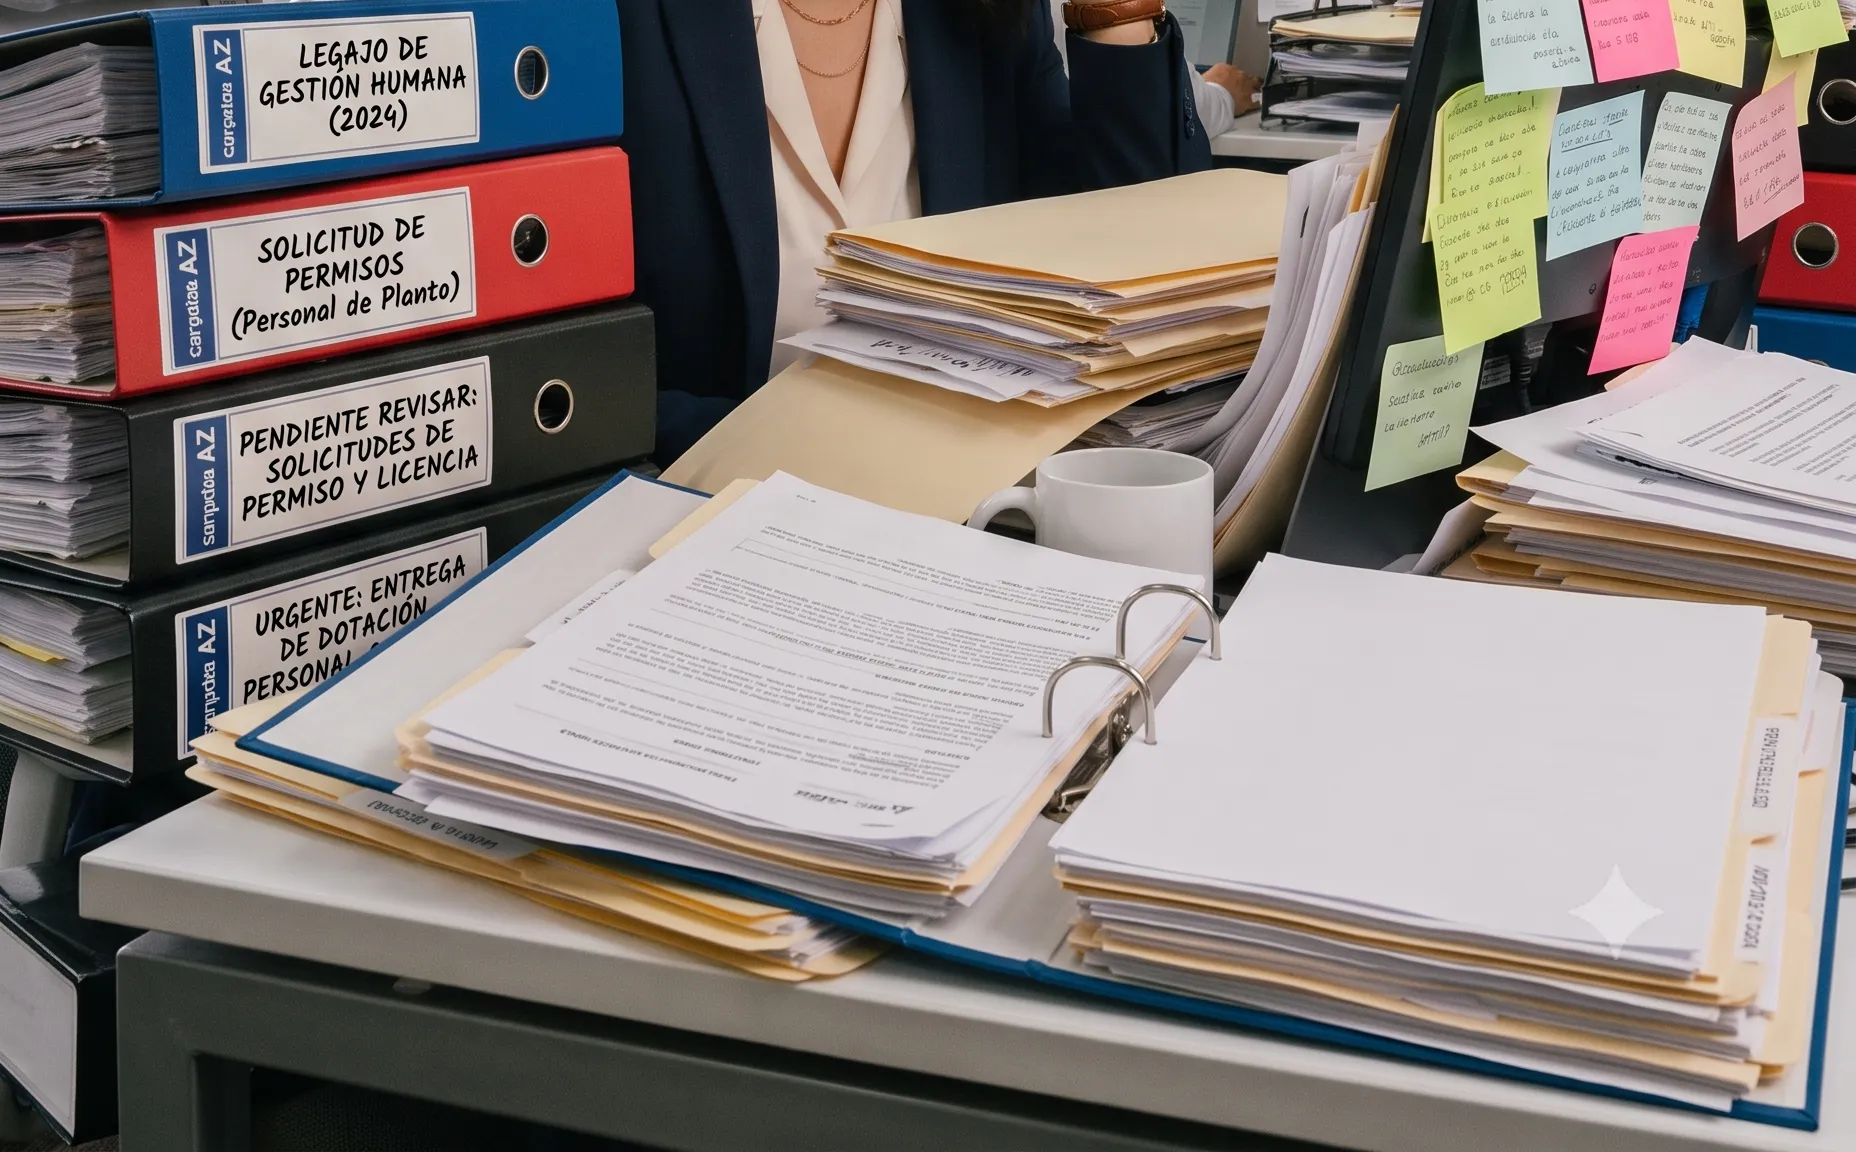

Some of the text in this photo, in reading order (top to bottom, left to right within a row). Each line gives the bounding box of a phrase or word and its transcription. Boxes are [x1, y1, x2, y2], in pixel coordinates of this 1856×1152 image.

[213, 38, 232, 74] AZ
[300, 35, 429, 72] LEGAJO DE
[259, 64, 467, 109] GESTIÓN HUMANA
[329, 98, 408, 137] (2024)
[177, 238, 198, 275] AZ
[257, 214, 426, 264] SOLICITUD DE
[285, 250, 404, 294] PERMISOS
[231, 270, 460, 341] (Personal de Planto)
[240, 384, 477, 457] PENDIENTE REVISAR:
[195, 426, 215, 462] AZ
[266, 418, 455, 483] SOLICITUDES DE
[242, 444, 479, 522] PERMISO Y LICENCIA
[255, 554, 466, 637] URGENTE: ENTREGA
[197, 618, 216, 654] AZ
[280, 593, 427, 662] DE DOTACIÓN
